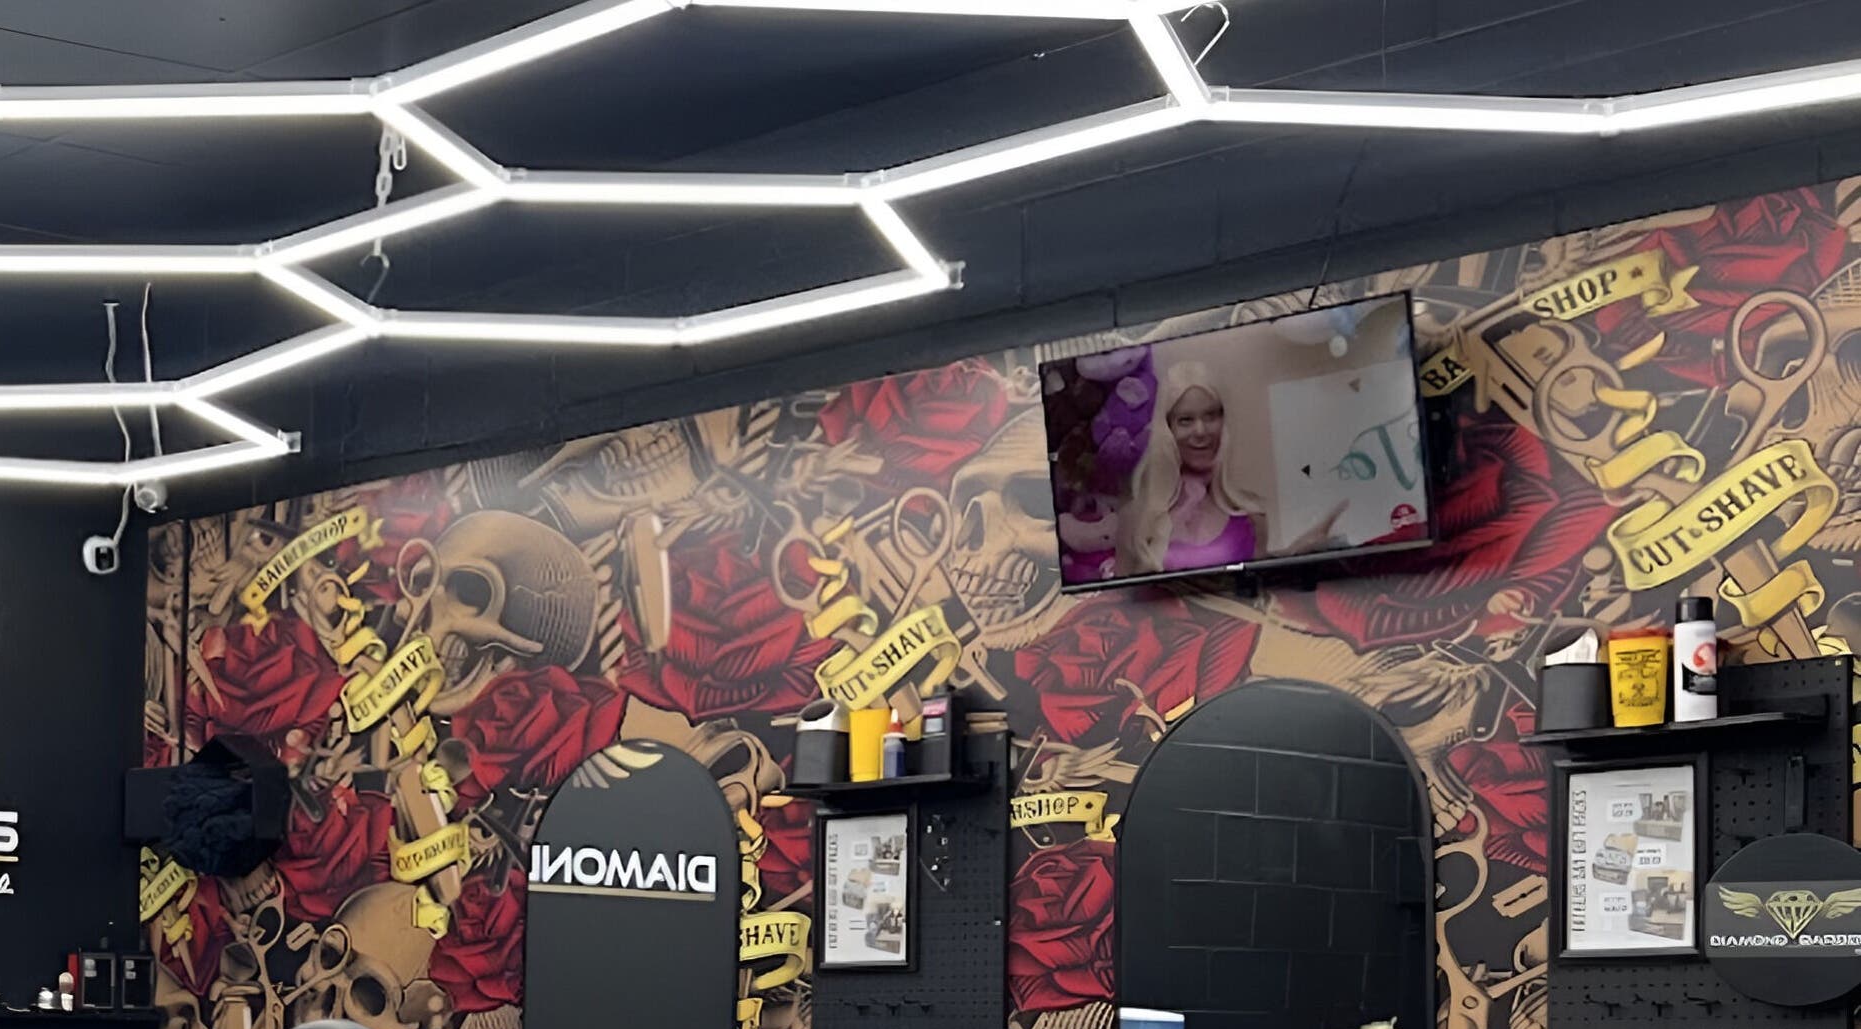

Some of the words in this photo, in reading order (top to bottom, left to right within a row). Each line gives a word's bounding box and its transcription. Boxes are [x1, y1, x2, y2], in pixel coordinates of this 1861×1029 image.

[1533, 268, 1619, 320] SHOP
[1629, 526, 1692, 574] CUT
[1697, 453, 1807, 532] SHAVE
[871, 618, 944, 676] SHAVE
[739, 922, 800, 948] HAVE
[1710, 934, 1789, 947] DIAMOND
